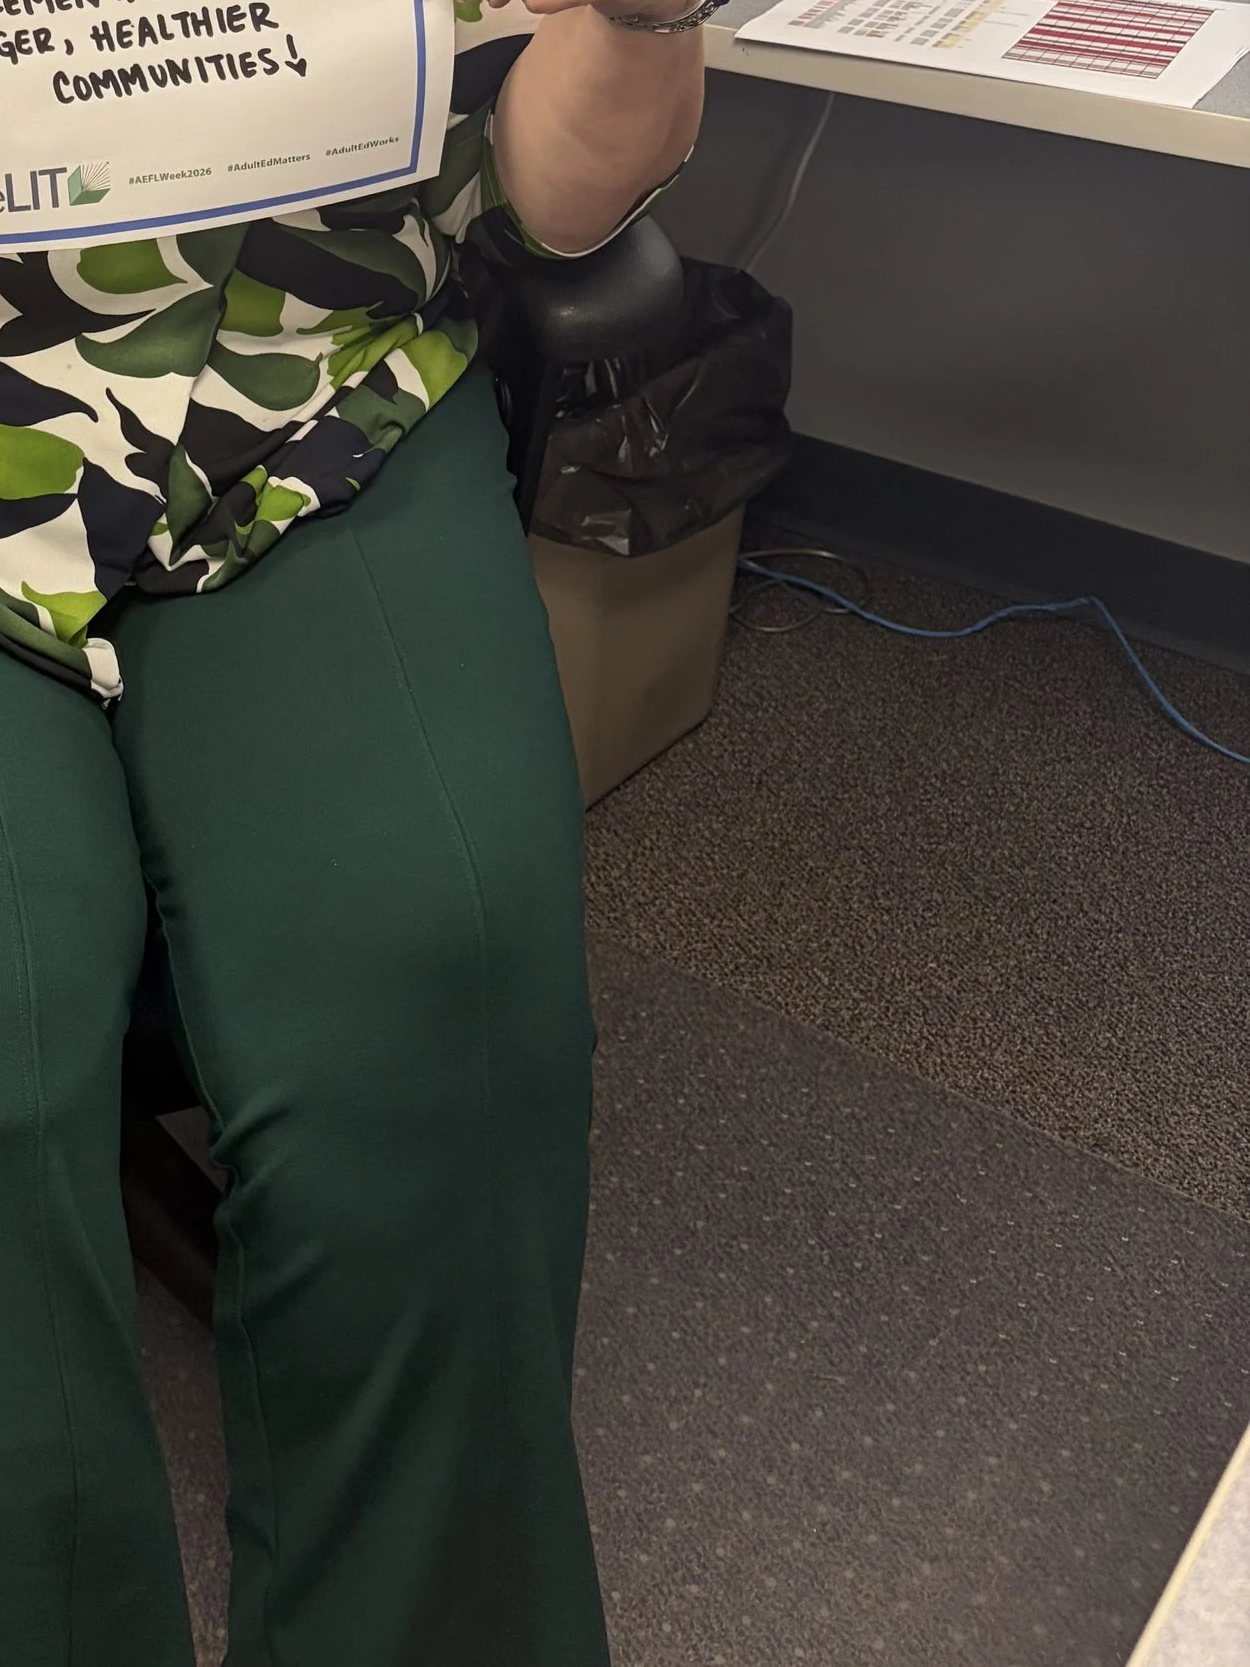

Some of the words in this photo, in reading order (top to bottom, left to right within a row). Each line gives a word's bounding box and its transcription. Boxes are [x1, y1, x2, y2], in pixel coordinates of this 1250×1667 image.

[90, 1, 279, 53] HEALTHIER
[129, 166, 212, 185] #AEFLWeek2026
[227, 153, 311, 172] #AdultEdMatters
[325, 136, 399, 156] #AdultEdWorks
